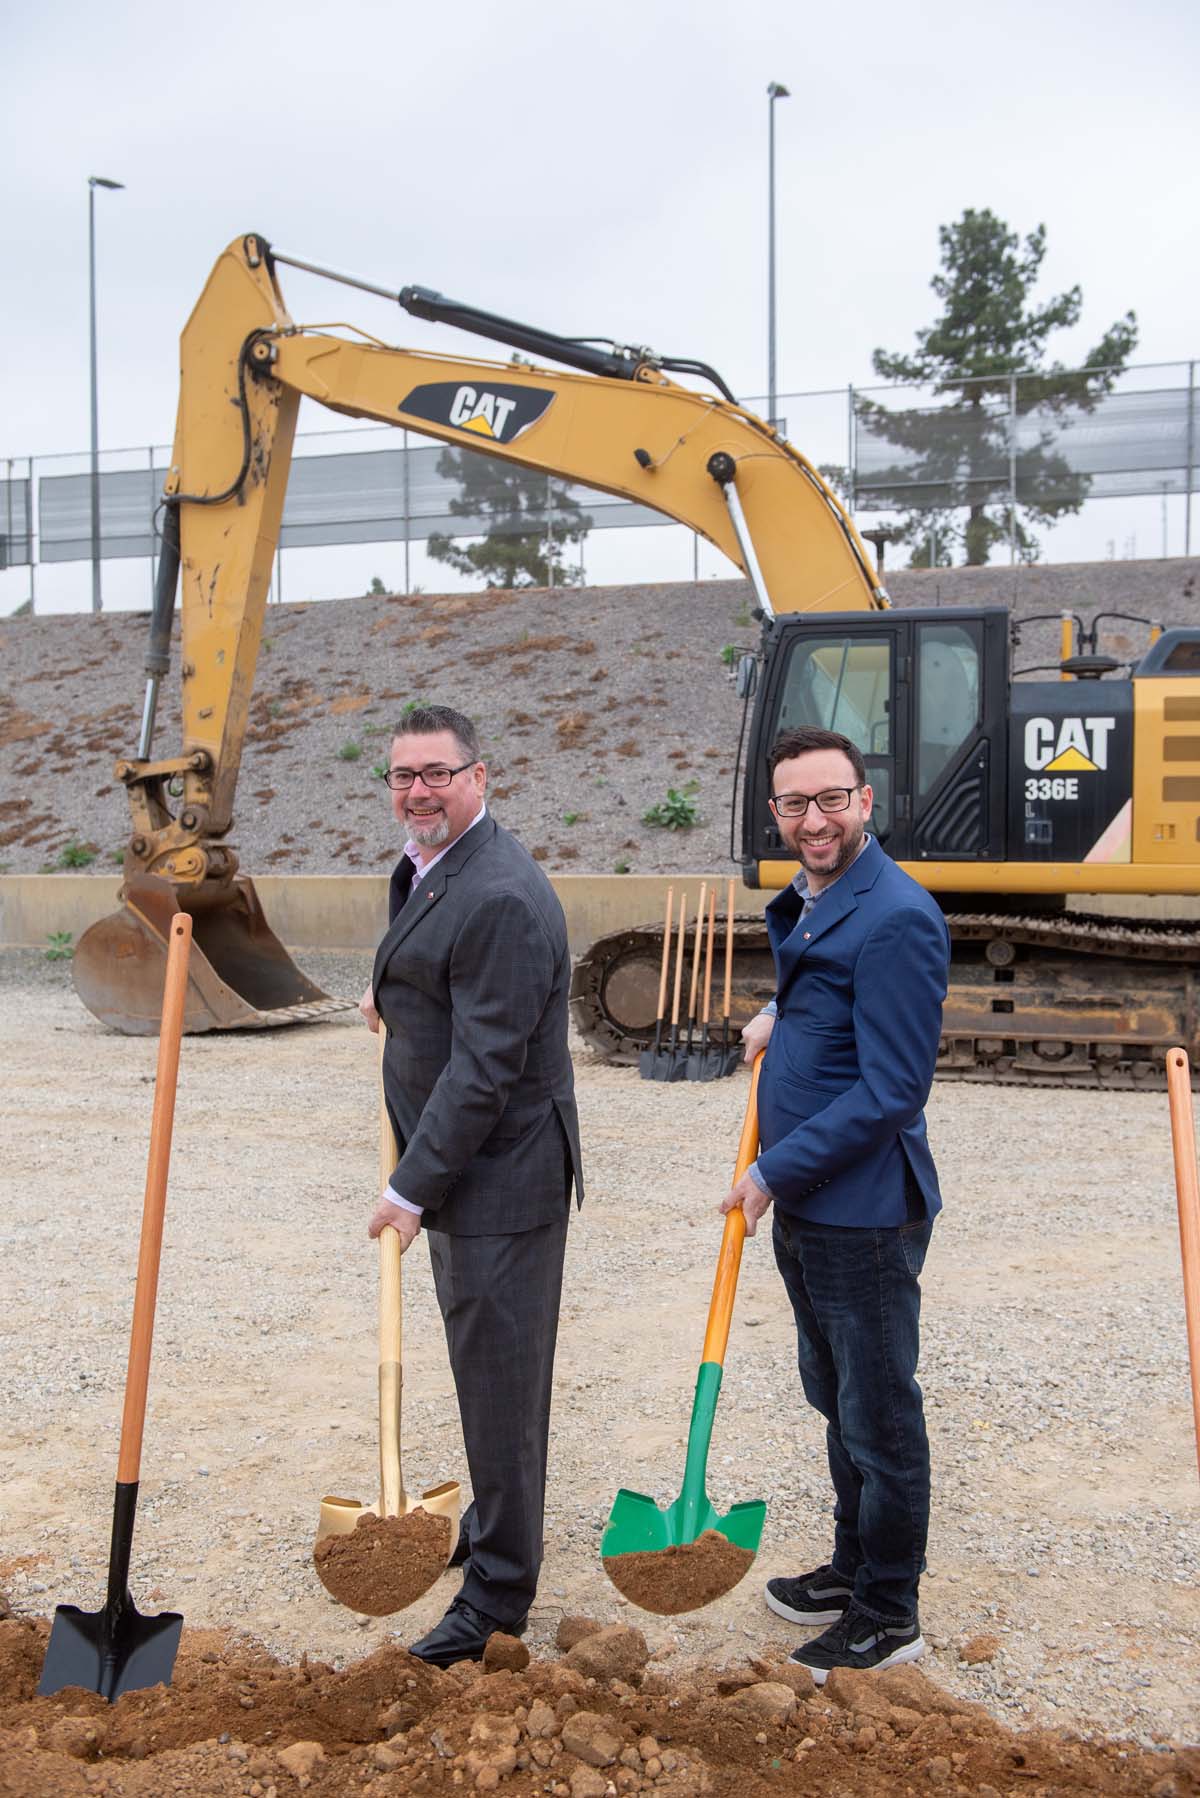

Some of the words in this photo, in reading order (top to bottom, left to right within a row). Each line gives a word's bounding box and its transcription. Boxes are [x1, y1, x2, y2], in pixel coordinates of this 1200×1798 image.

[449, 385, 516, 439] CAT
[1024, 717, 1116, 771] CAT
[1025, 778, 1079, 800] 336E
